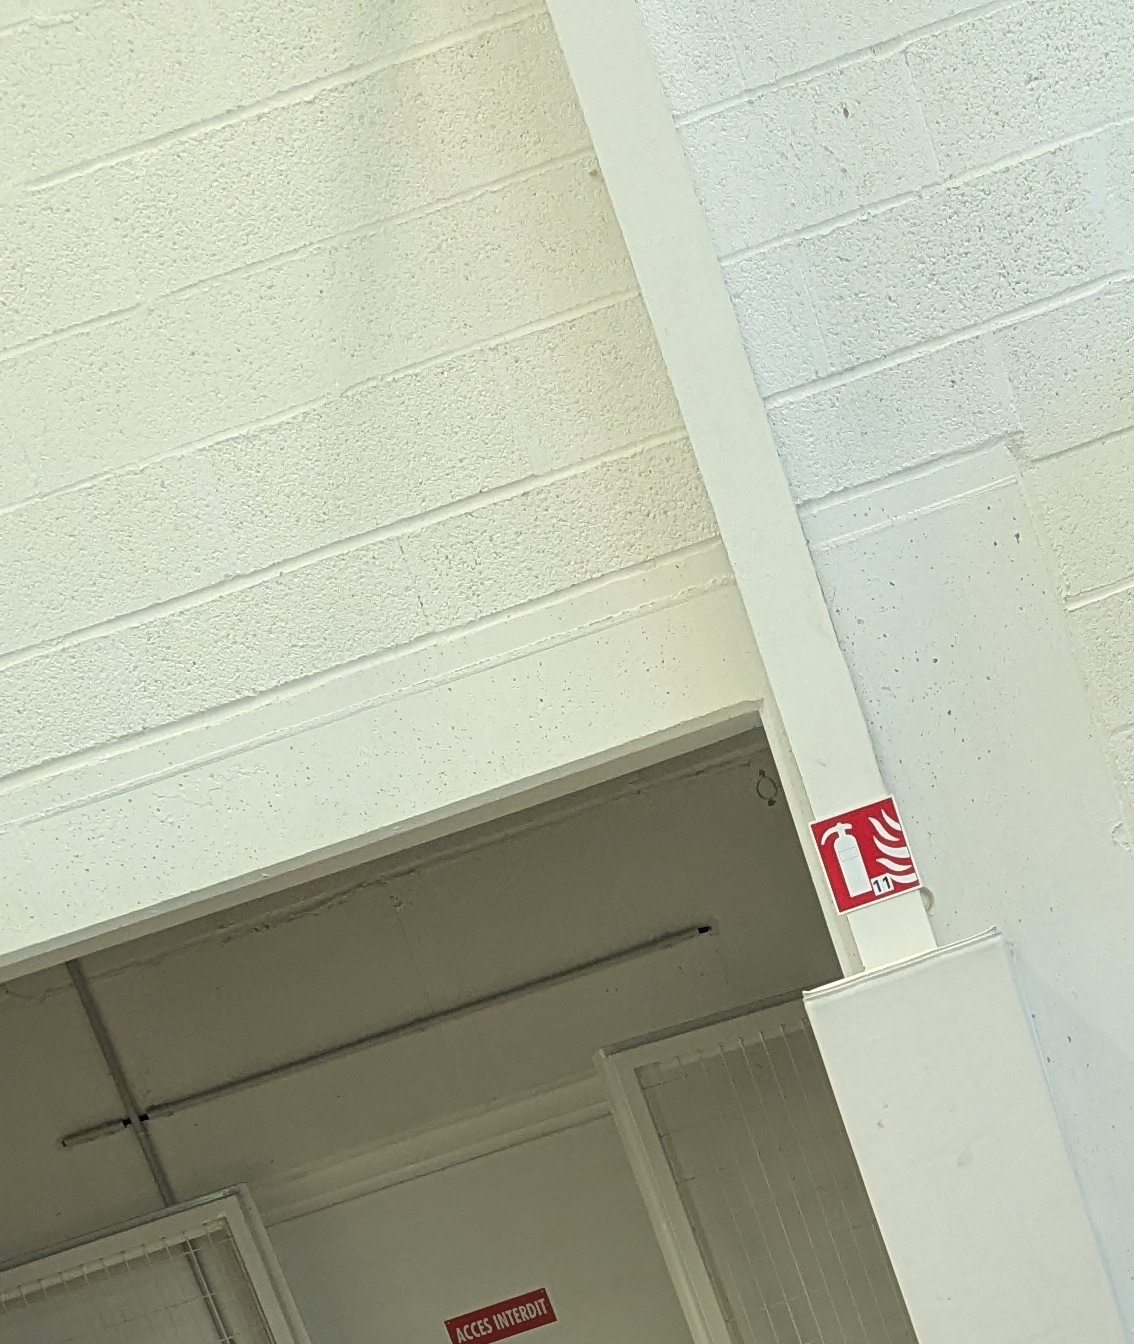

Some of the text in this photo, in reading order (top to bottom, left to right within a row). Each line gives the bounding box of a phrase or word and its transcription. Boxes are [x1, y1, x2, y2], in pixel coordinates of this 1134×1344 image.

[872, 876, 892, 893] 11
[455, 1298, 548, 1344] ACCES INTERDIT
